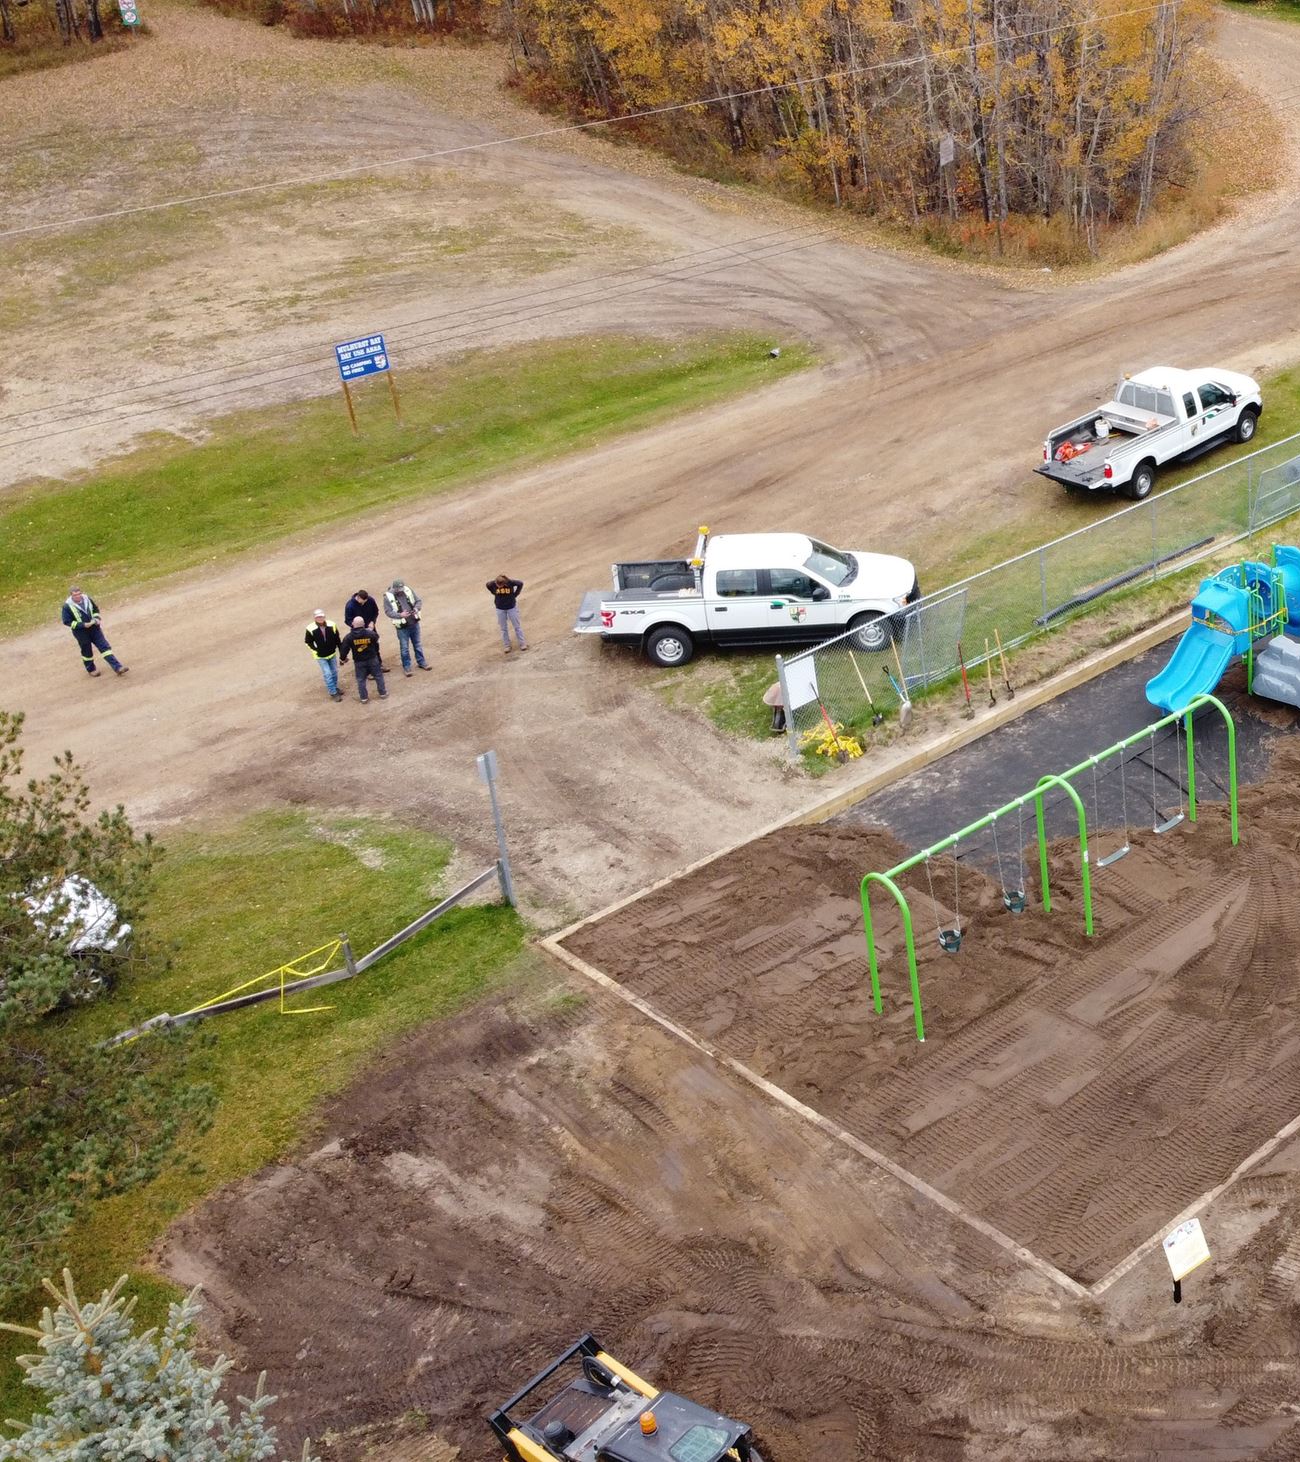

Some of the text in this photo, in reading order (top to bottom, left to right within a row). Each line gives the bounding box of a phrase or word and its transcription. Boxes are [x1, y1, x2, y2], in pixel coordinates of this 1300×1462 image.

[370, 337, 381, 345] BAY
[340, 352, 352, 360] DAY
[365, 345, 382, 353] AREA
[350, 360, 372, 368] CAMPING
